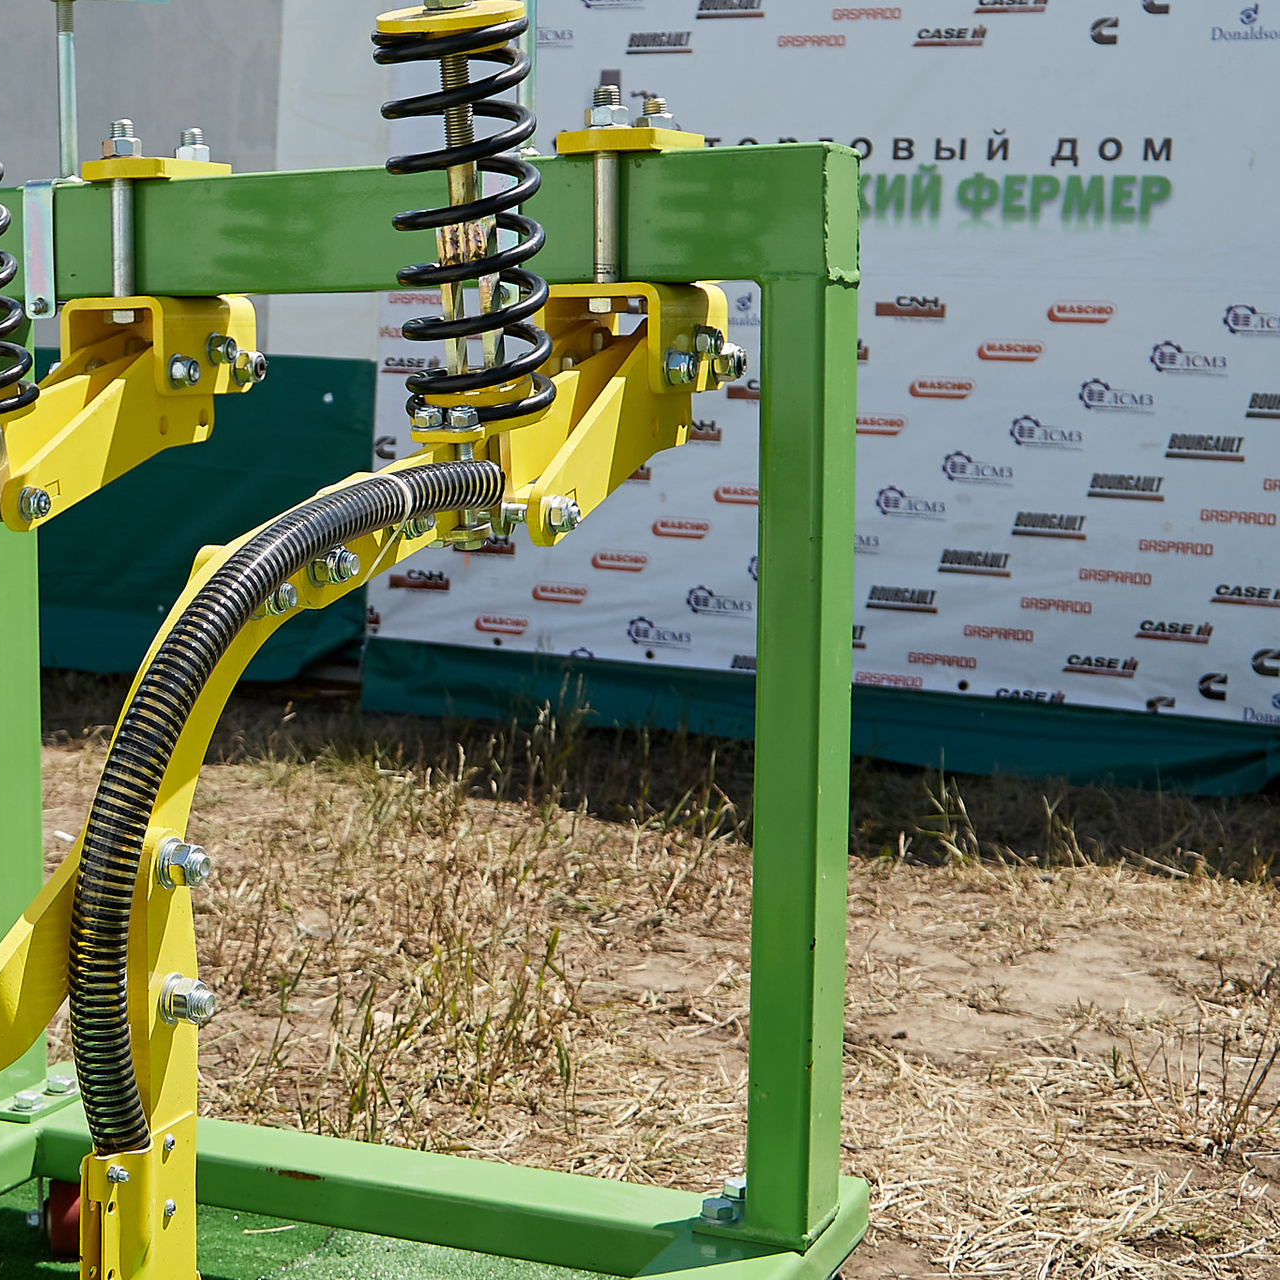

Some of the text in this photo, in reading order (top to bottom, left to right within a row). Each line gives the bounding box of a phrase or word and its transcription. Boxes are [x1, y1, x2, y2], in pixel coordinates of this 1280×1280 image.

[832, 7, 902, 20] GASPARDO
[777, 34, 846, 47] GASPARDO
[917, 28, 968, 40] CASE
[1211, 26, 1280, 41] Donaldso
[956, 173, 1172, 218] ФЕРМЕР
[1056, 304, 1114, 316] MASCHIO
[986, 342, 1042, 355] MASCHIO
[385, 356, 425, 368] CASE
[919, 381, 973, 392] MASCHIO
[1200, 509, 1277, 526] GASPARDO
[661, 522, 709, 533] MASCHIO
[1139, 538, 1213, 556] GASPARDO
[600, 555, 647, 566] MASCHIO
[1079, 568, 1152, 585] GASPARDO
[542, 587, 588, 598] MASCHIO
[1215, 584, 1270, 600] CASE
[1021, 596, 1092, 614] GASPARDO
[482, 617, 529, 629] MASCHIO
[1140, 620, 1193, 635] CASE
[963, 624, 1034, 642] GASPARDO
[908, 651, 977, 669] GASPARDO
[1067, 654, 1119, 669] CASE
[996, 687, 1046, 702] CASE
